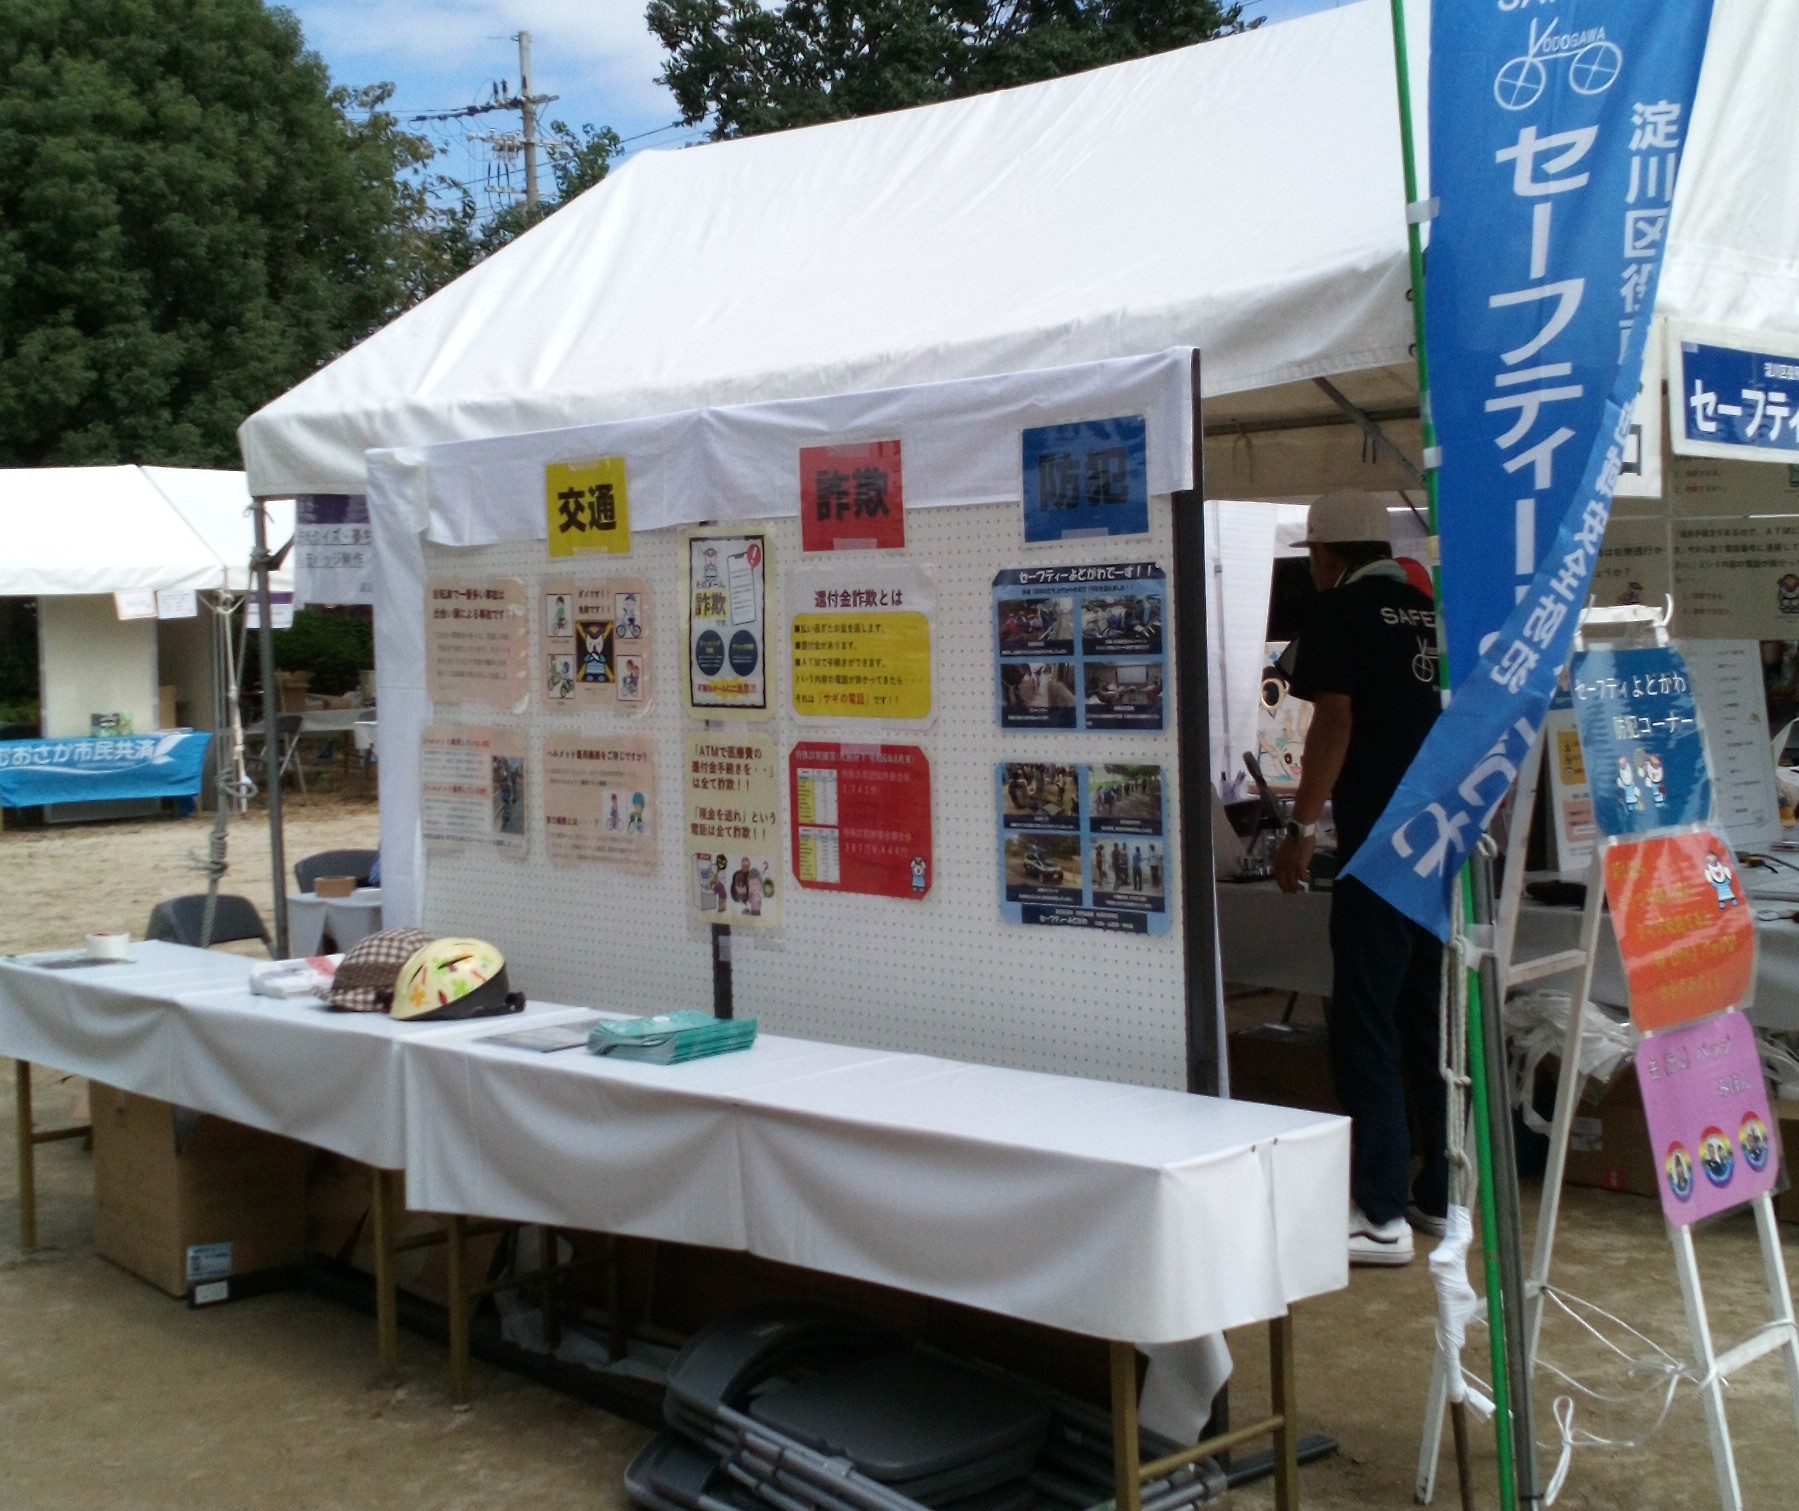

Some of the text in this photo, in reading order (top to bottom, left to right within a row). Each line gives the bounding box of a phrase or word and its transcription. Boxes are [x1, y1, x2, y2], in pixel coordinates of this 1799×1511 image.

[1478, 124, 1599, 656] セーフティー
[815, 466, 890, 522] 詐欺
[1039, 447, 1130, 512] 防犯
[557, 483, 617, 533] 交通
[695, 592, 727, 617] 詐欺
[814, 589, 903, 608] 還付金詐欺とは
[1612, 709, 1694, 739] 防犯コーナー
